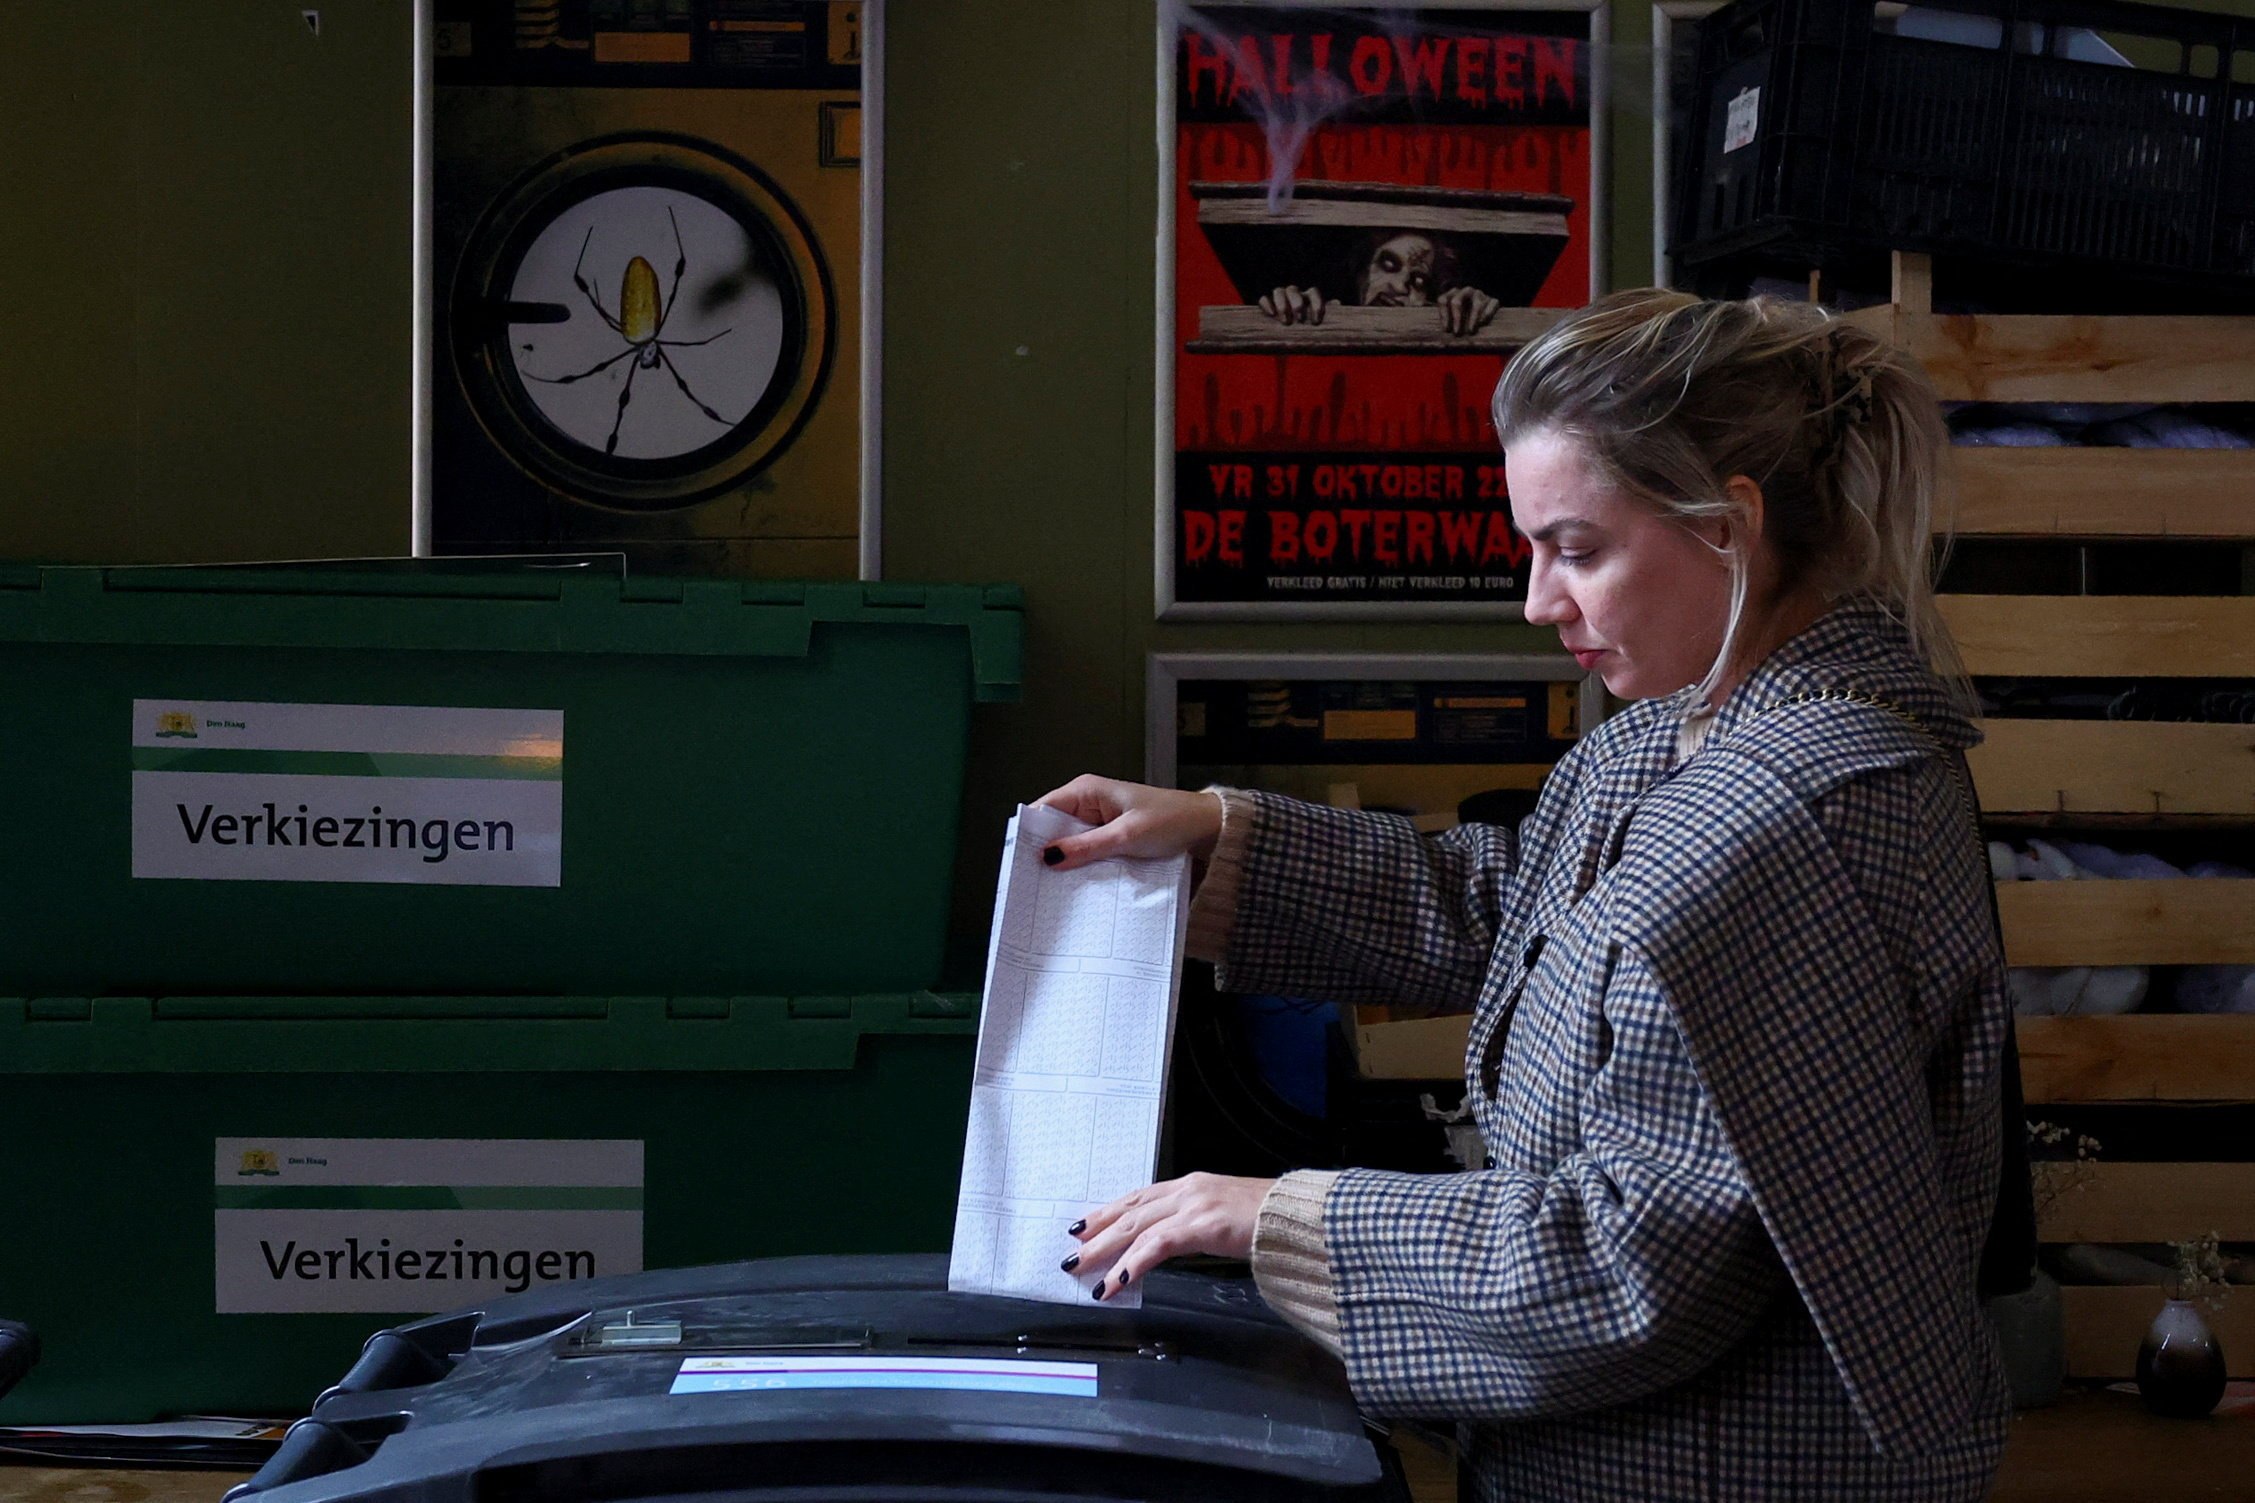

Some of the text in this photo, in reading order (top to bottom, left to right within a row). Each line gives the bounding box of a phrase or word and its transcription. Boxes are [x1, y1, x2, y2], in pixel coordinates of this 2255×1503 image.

[1184, 34, 1577, 108] HALLOWEEN
[1208, 464, 1253, 499] VR
[1266, 464, 1299, 498] 31
[1312, 464, 1465, 501] OKTOBER
[1183, 509, 1248, 567] DE
[1266, 576, 1324, 589] VERKLEED
[1327, 576, 1367, 589] GRATIS
[1378, 576, 1405, 589] NIET
[1409, 576, 1466, 589] VERKLEED
[1484, 576, 1515, 589] EURO
[177, 802, 515, 864] Verkiezingen
[259, 1237, 596, 1294] Verkiezingen
